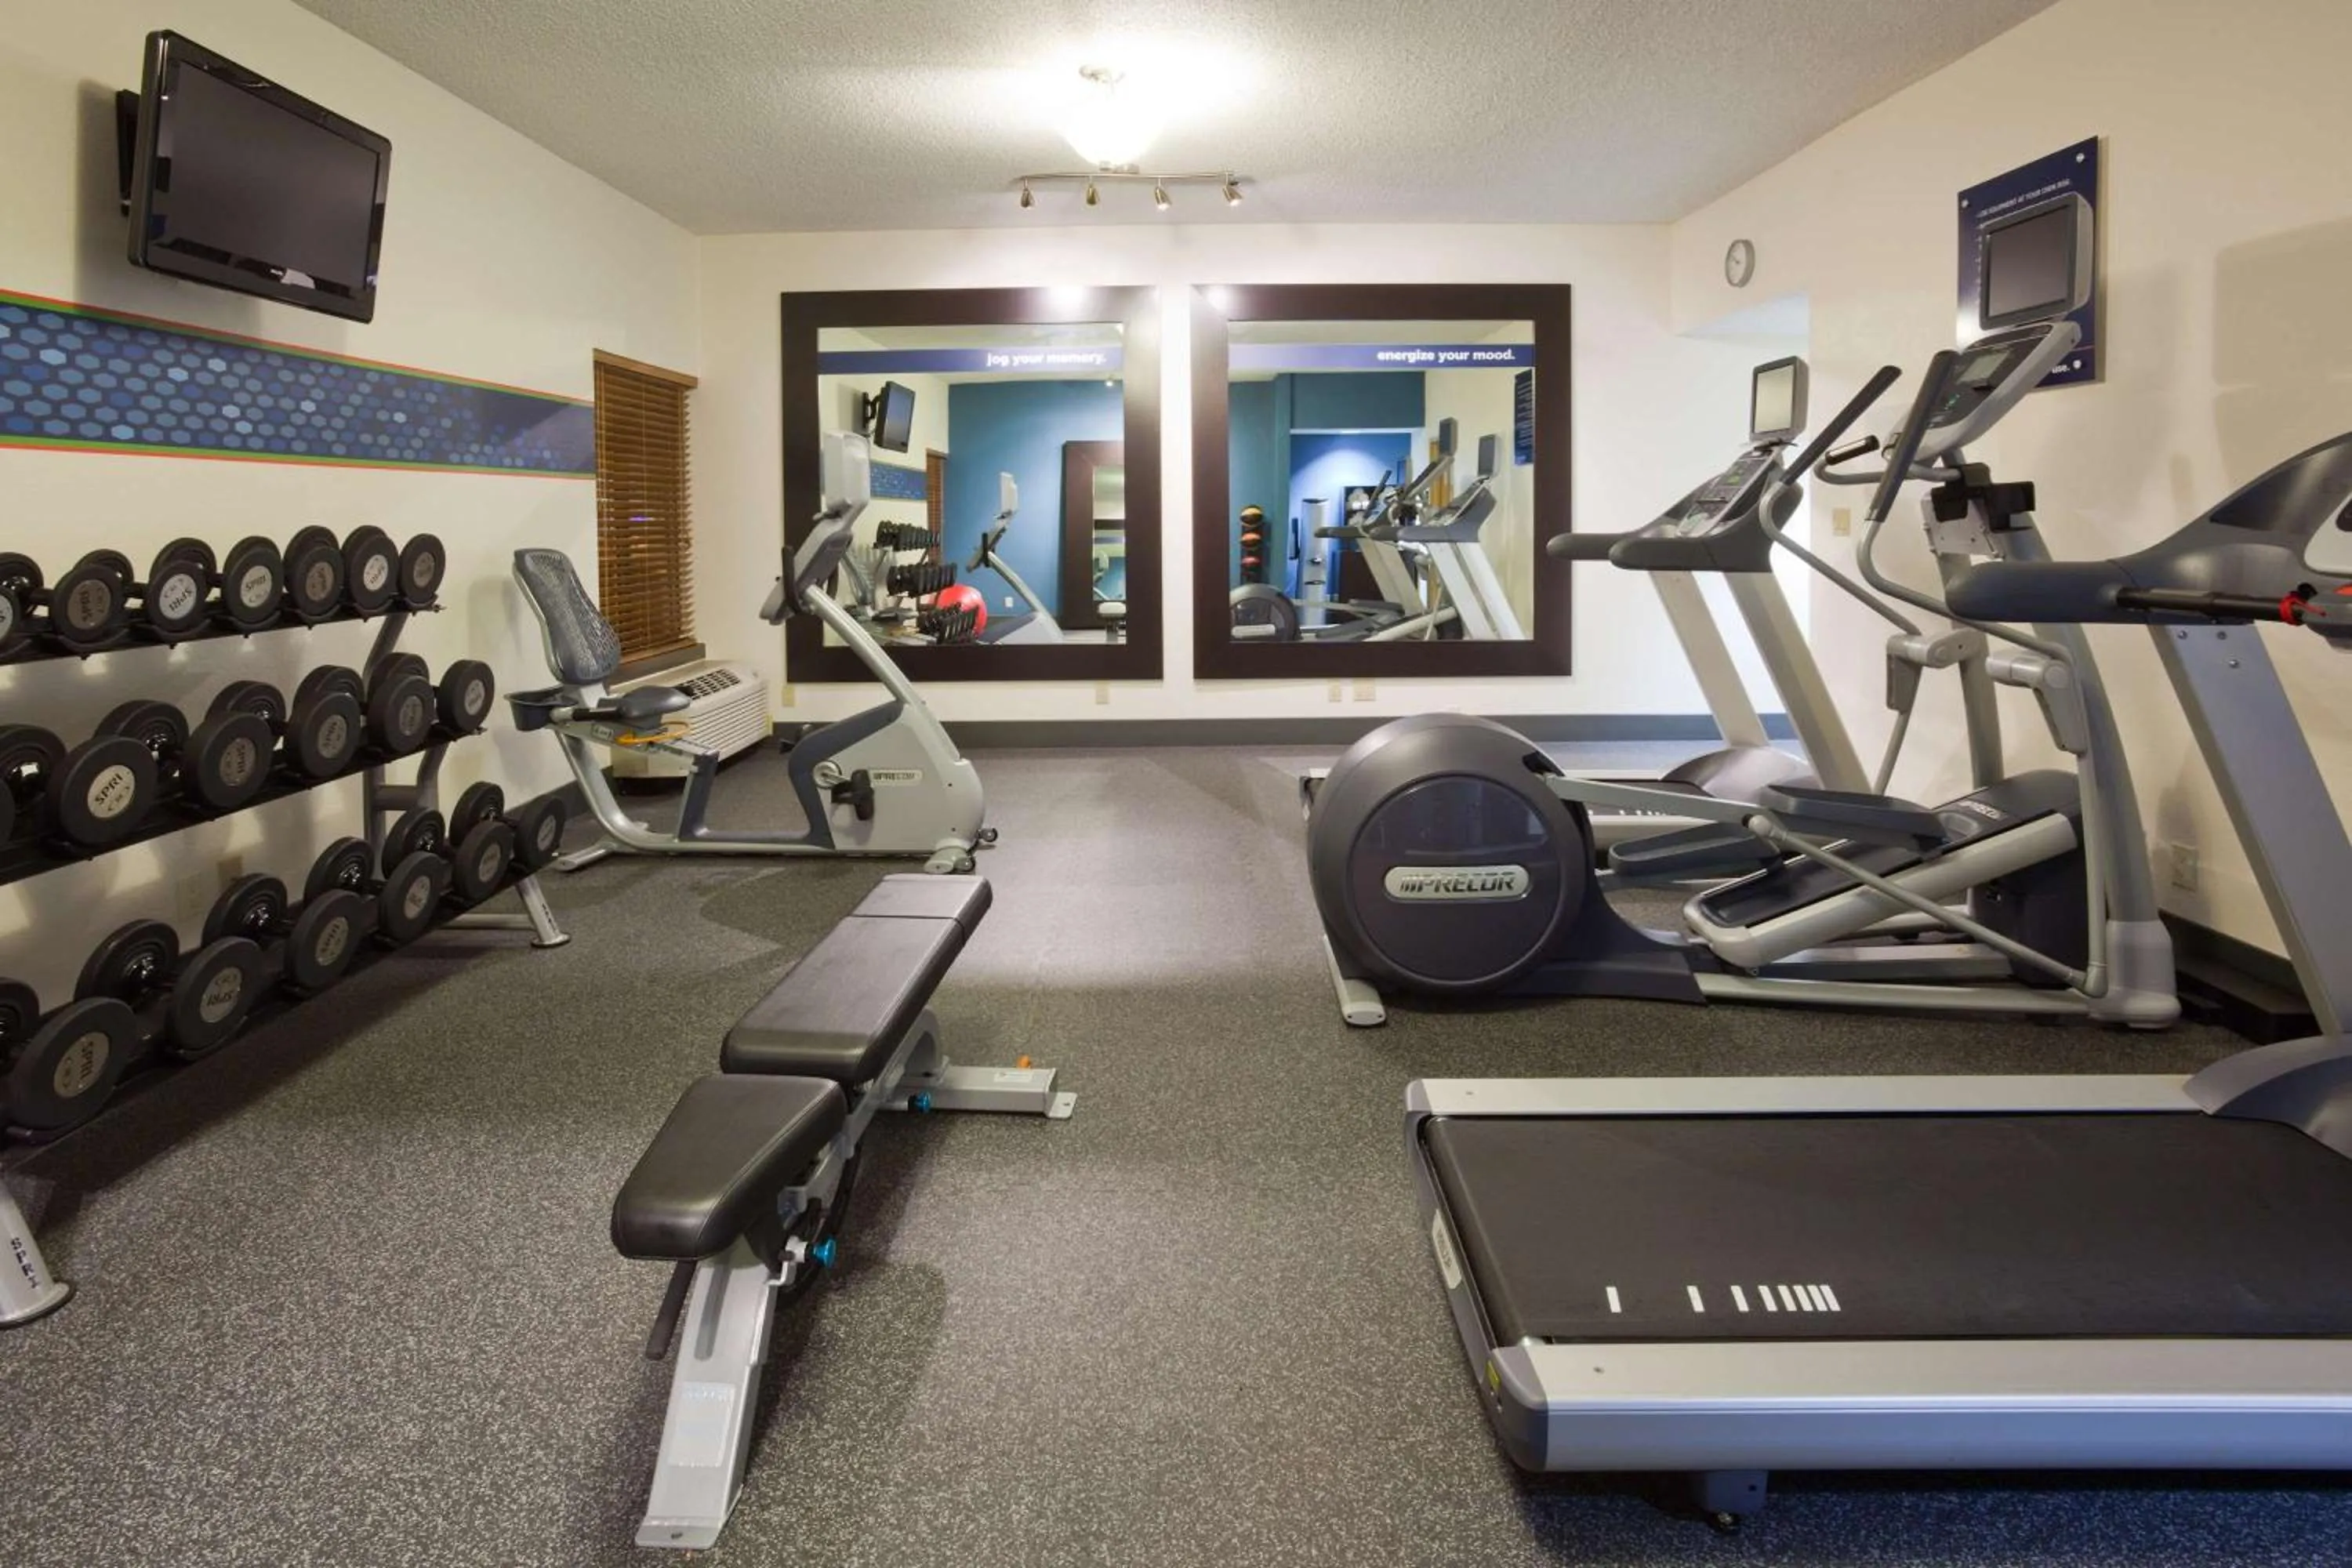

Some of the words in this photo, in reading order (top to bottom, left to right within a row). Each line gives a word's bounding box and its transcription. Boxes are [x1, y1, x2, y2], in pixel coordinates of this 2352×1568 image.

[986, 351, 1010, 367] jog
[1012, 354, 1044, 367] your
[1046, 353, 1107, 365] memory.
[1377, 349, 1436, 364] energize
[1439, 351, 1469, 364] your
[1473, 348, 1515, 361] mood.
[94, 773, 124, 805] SPRI
[1414, 871, 1515, 893] PRECOR
[11, 1237, 42, 1290] SPRI
